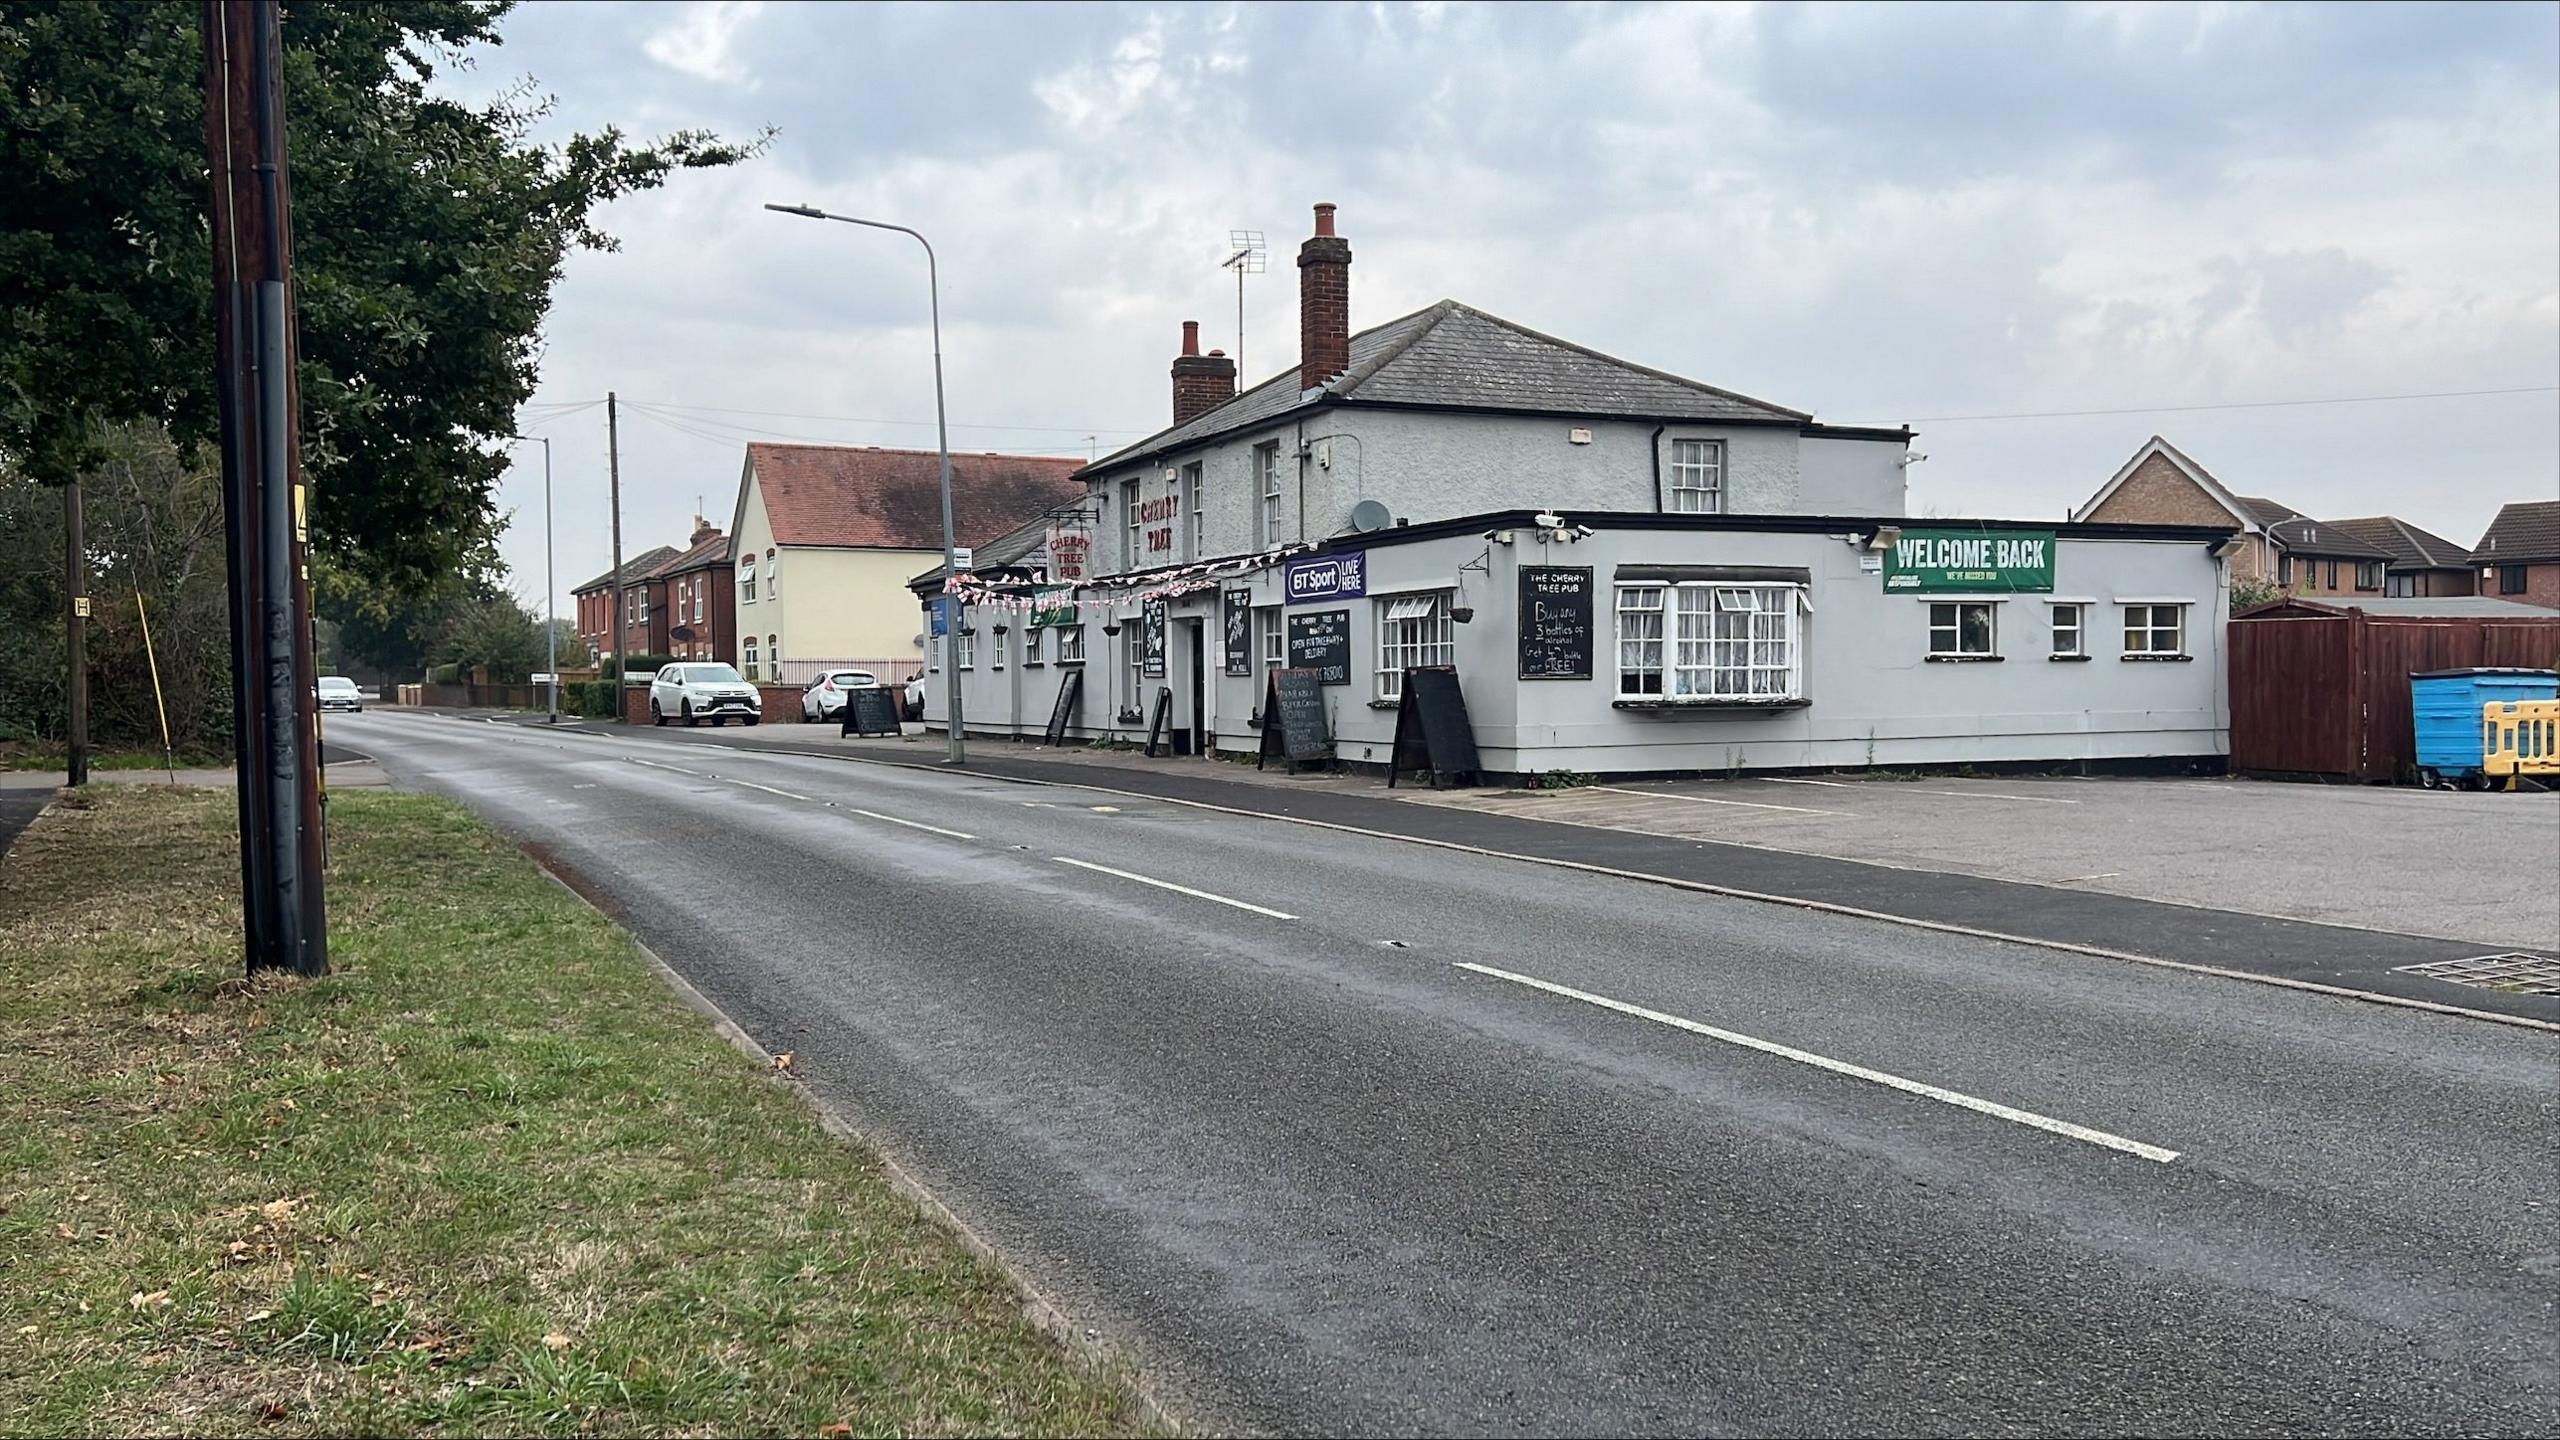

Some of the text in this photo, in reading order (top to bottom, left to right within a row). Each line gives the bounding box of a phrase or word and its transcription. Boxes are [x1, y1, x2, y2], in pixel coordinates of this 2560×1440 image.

[1141, 495, 1179, 524] CHERRY
[1050, 535, 1091, 551] CHERRY
[1147, 527, 1172, 553] TREE
[1056, 553, 1085, 564] TREE
[1896, 539, 2045, 569] WELCOME BACK
[1060, 566, 1081, 577] PUB
[1341, 559, 1359, 576] LIVE
[1294, 567, 1336, 591] BT Sport
[1341, 574, 1361, 591] HERE
[1529, 573, 1585, 583] THE CHERRY
[1537, 583, 1580, 593] TREE PUB
[77, 600, 88, 614] H
[1535, 601, 1576, 626] Buy any
[1535, 624, 1544, 637] 3
[1545, 623, 1573, 636] bottles
[1525, 645, 1542, 658] Get
[1545, 659, 1575, 672] FREE!
